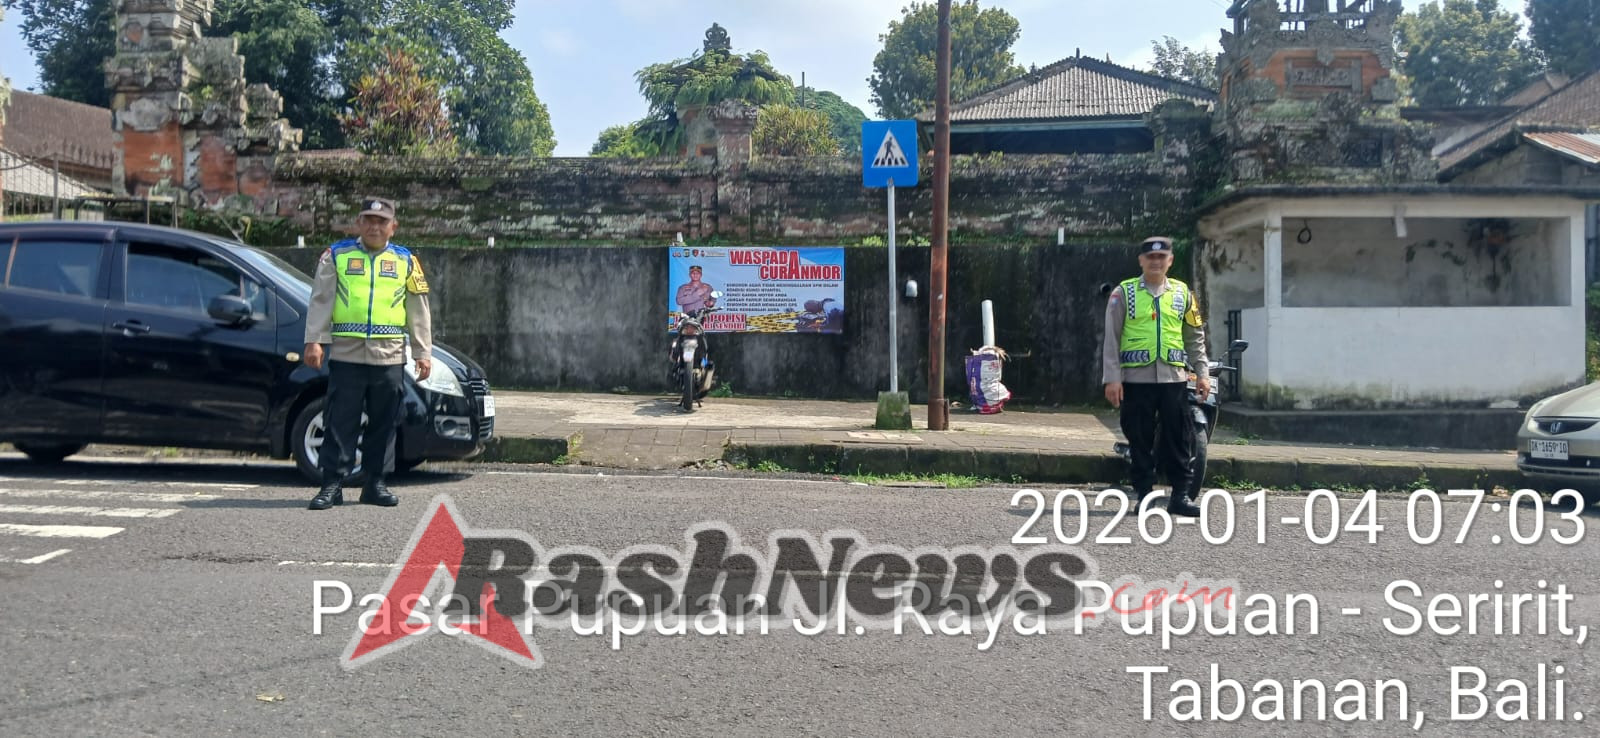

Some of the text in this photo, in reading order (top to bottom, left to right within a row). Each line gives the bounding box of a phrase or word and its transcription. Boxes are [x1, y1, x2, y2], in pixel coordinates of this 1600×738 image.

[729, 250, 801, 265] WASPADA
[759, 264, 842, 280] CURANMOR
[710, 313, 745, 323] POLISI
